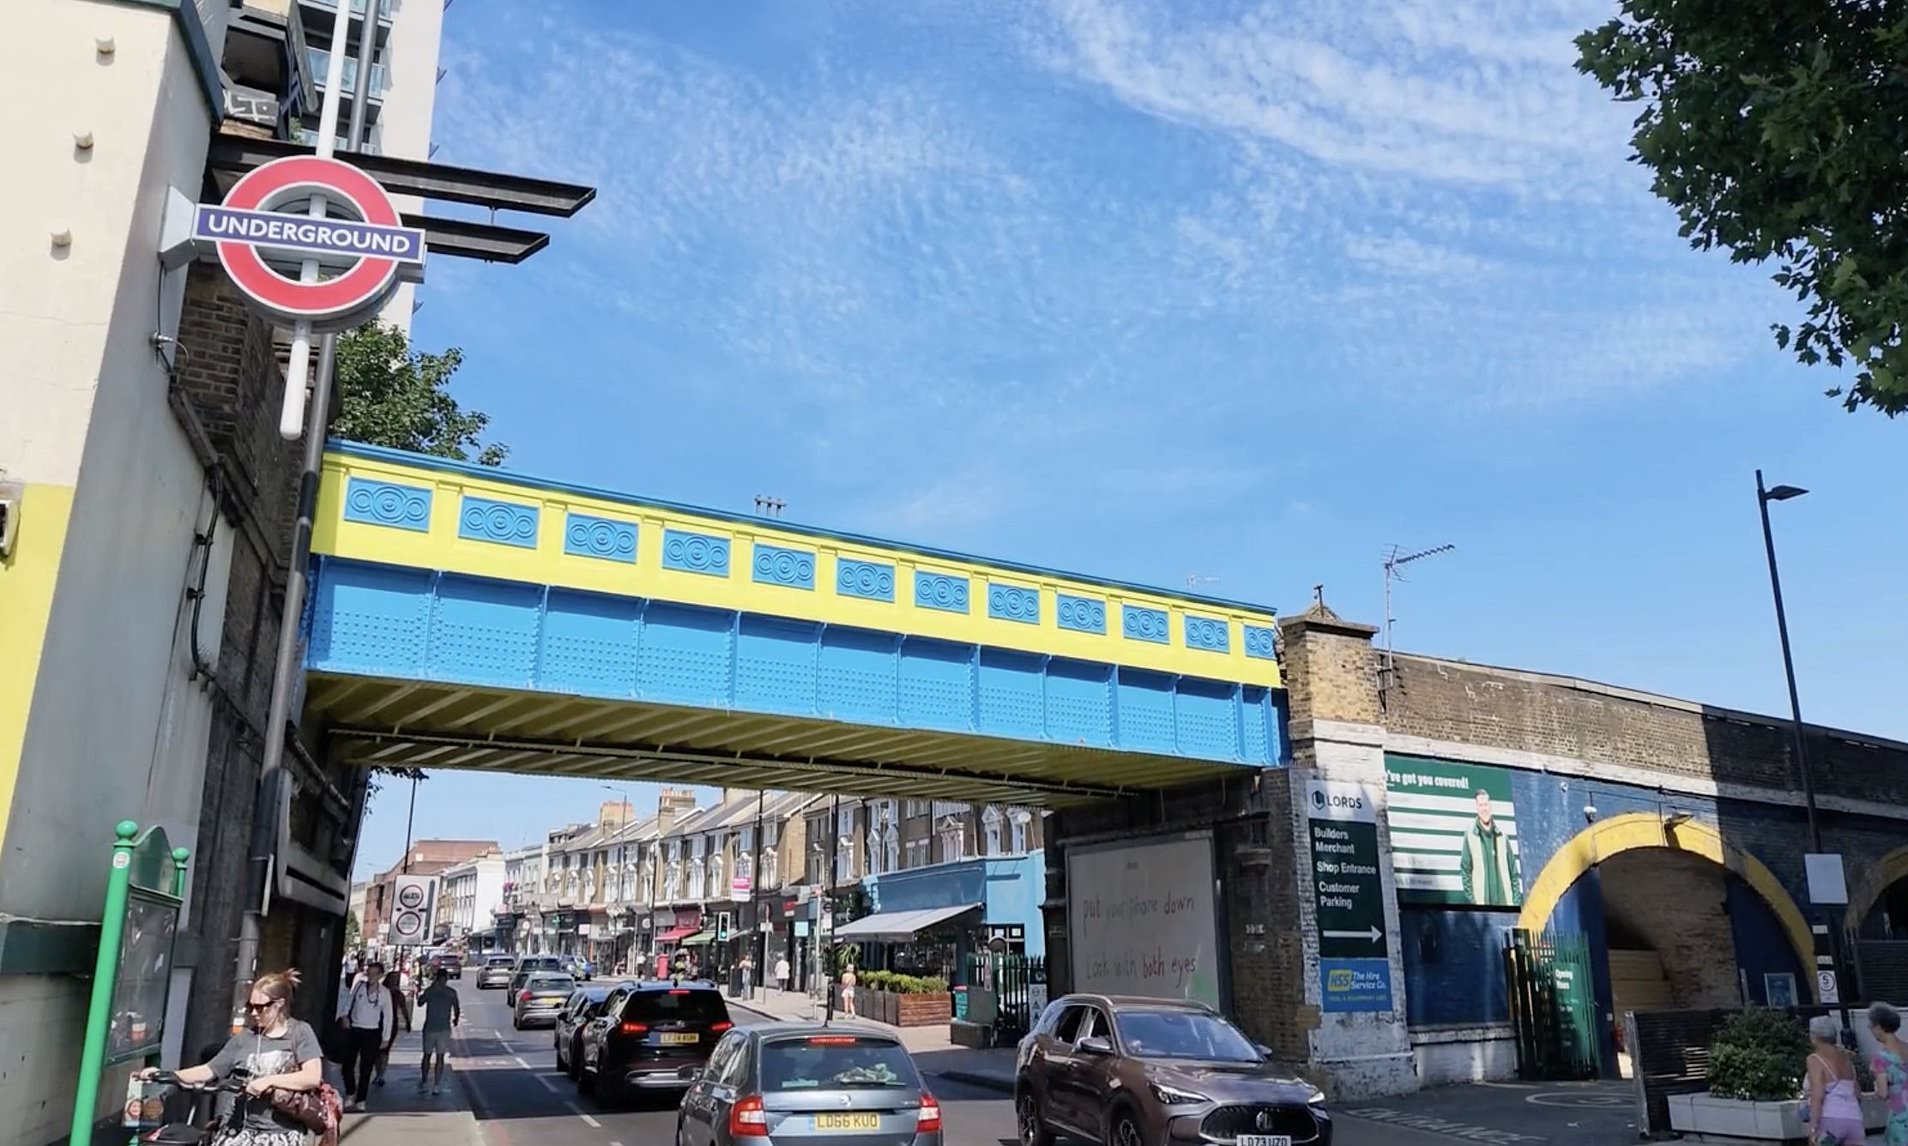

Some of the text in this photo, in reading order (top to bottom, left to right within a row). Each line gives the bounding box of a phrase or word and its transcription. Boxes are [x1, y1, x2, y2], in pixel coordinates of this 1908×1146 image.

[208, 214, 410, 253] UNDERGROUND
[1402, 773, 1417, 786] got
[1418, 775, 1433, 787] you
[1434, 777, 1469, 789] covered!
[1327, 795, 1362, 809] LORDS
[1314, 827, 1349, 839] Builders
[1316, 841, 1355, 855] Merchant
[1317, 861, 1376, 875] Shop Entrance
[1319, 881, 1360, 893] Customer
[1320, 896, 1352, 910] Parking
[1083, 894, 1101, 938] put
[1163, 889, 1195, 915] down
[1142, 946, 1165, 979] both
[1171, 957, 1196, 989] eyes
[1366, 971, 1380, 980] Hire
[1351, 980, 1375, 989] Service
[816, 1114, 878, 1128] LD66 KUO
